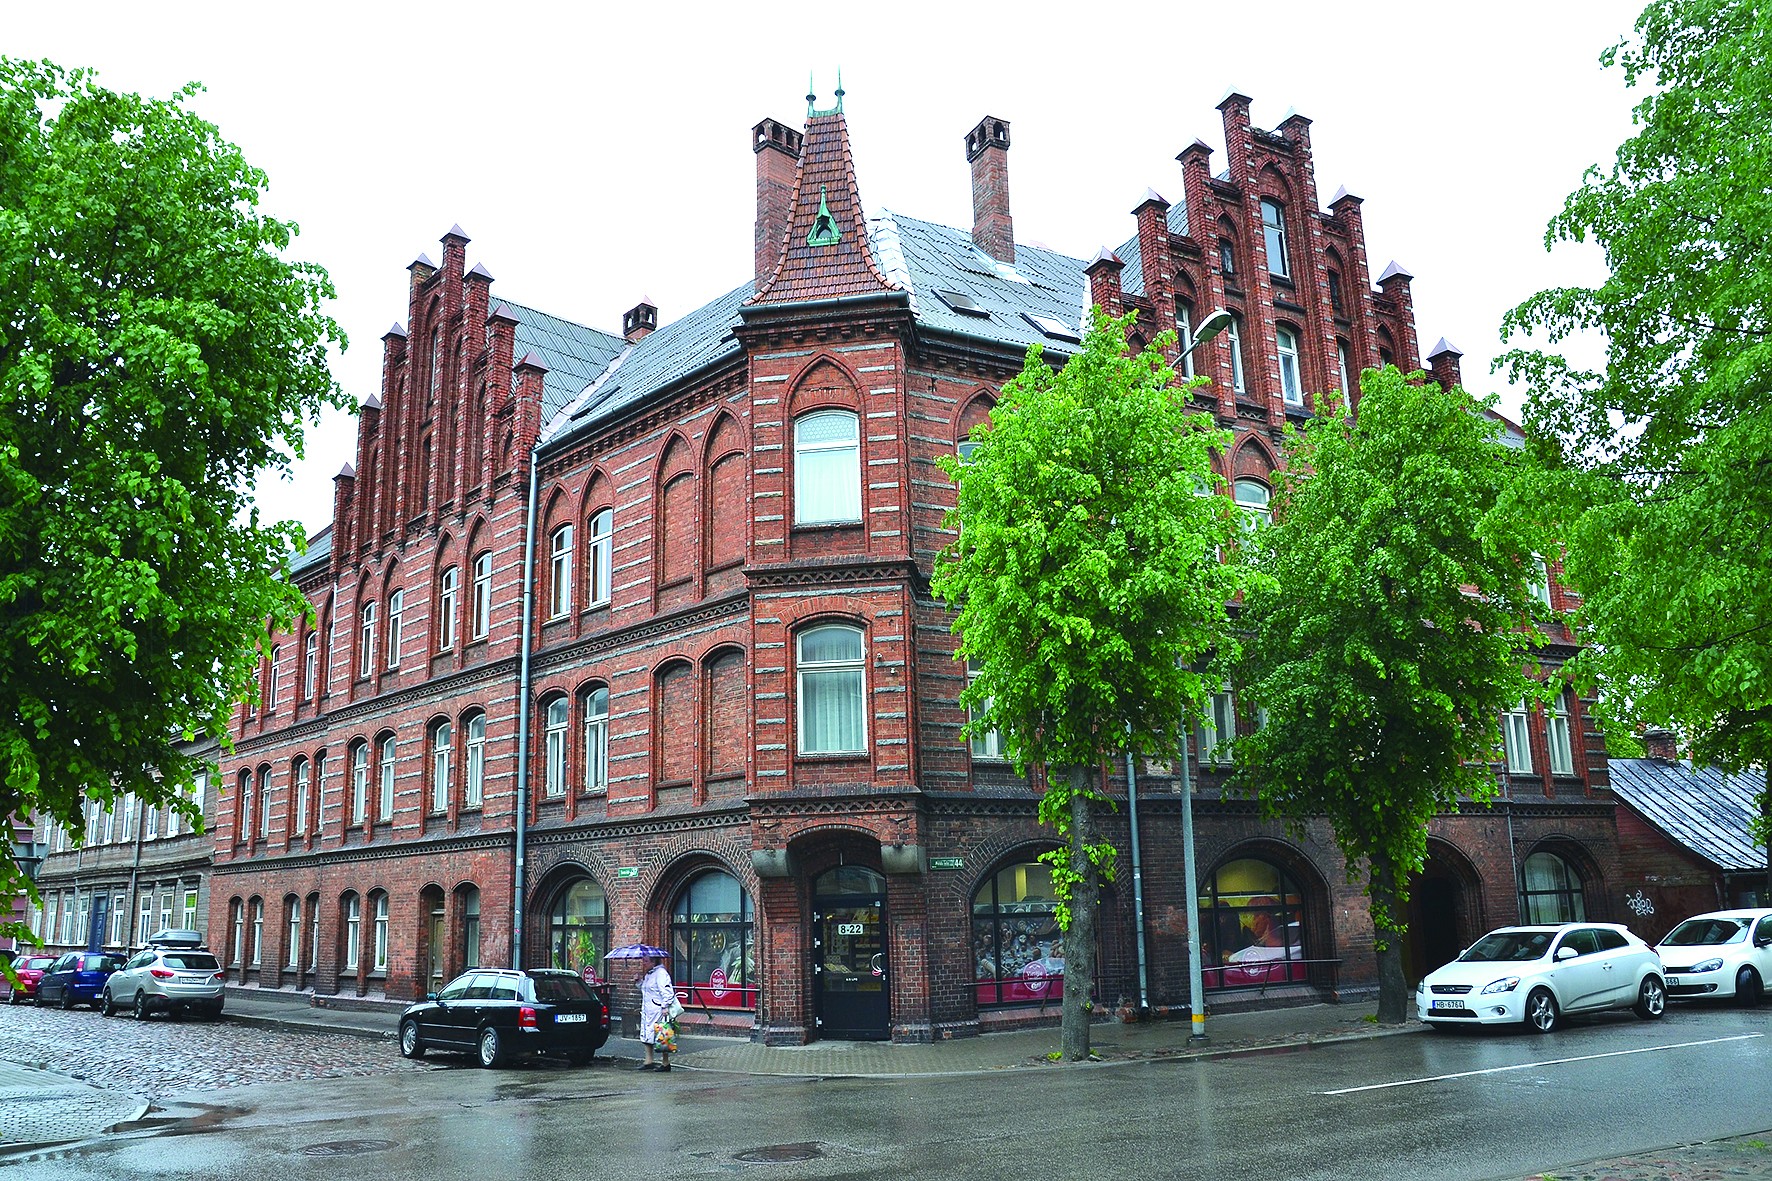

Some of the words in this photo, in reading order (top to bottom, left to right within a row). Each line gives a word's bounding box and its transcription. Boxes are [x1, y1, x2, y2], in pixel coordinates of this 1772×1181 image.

[954, 859, 963, 867] 44
[840, 924, 861, 933] 8-22
[1436, 1001, 1463, 1009] HB-6764
